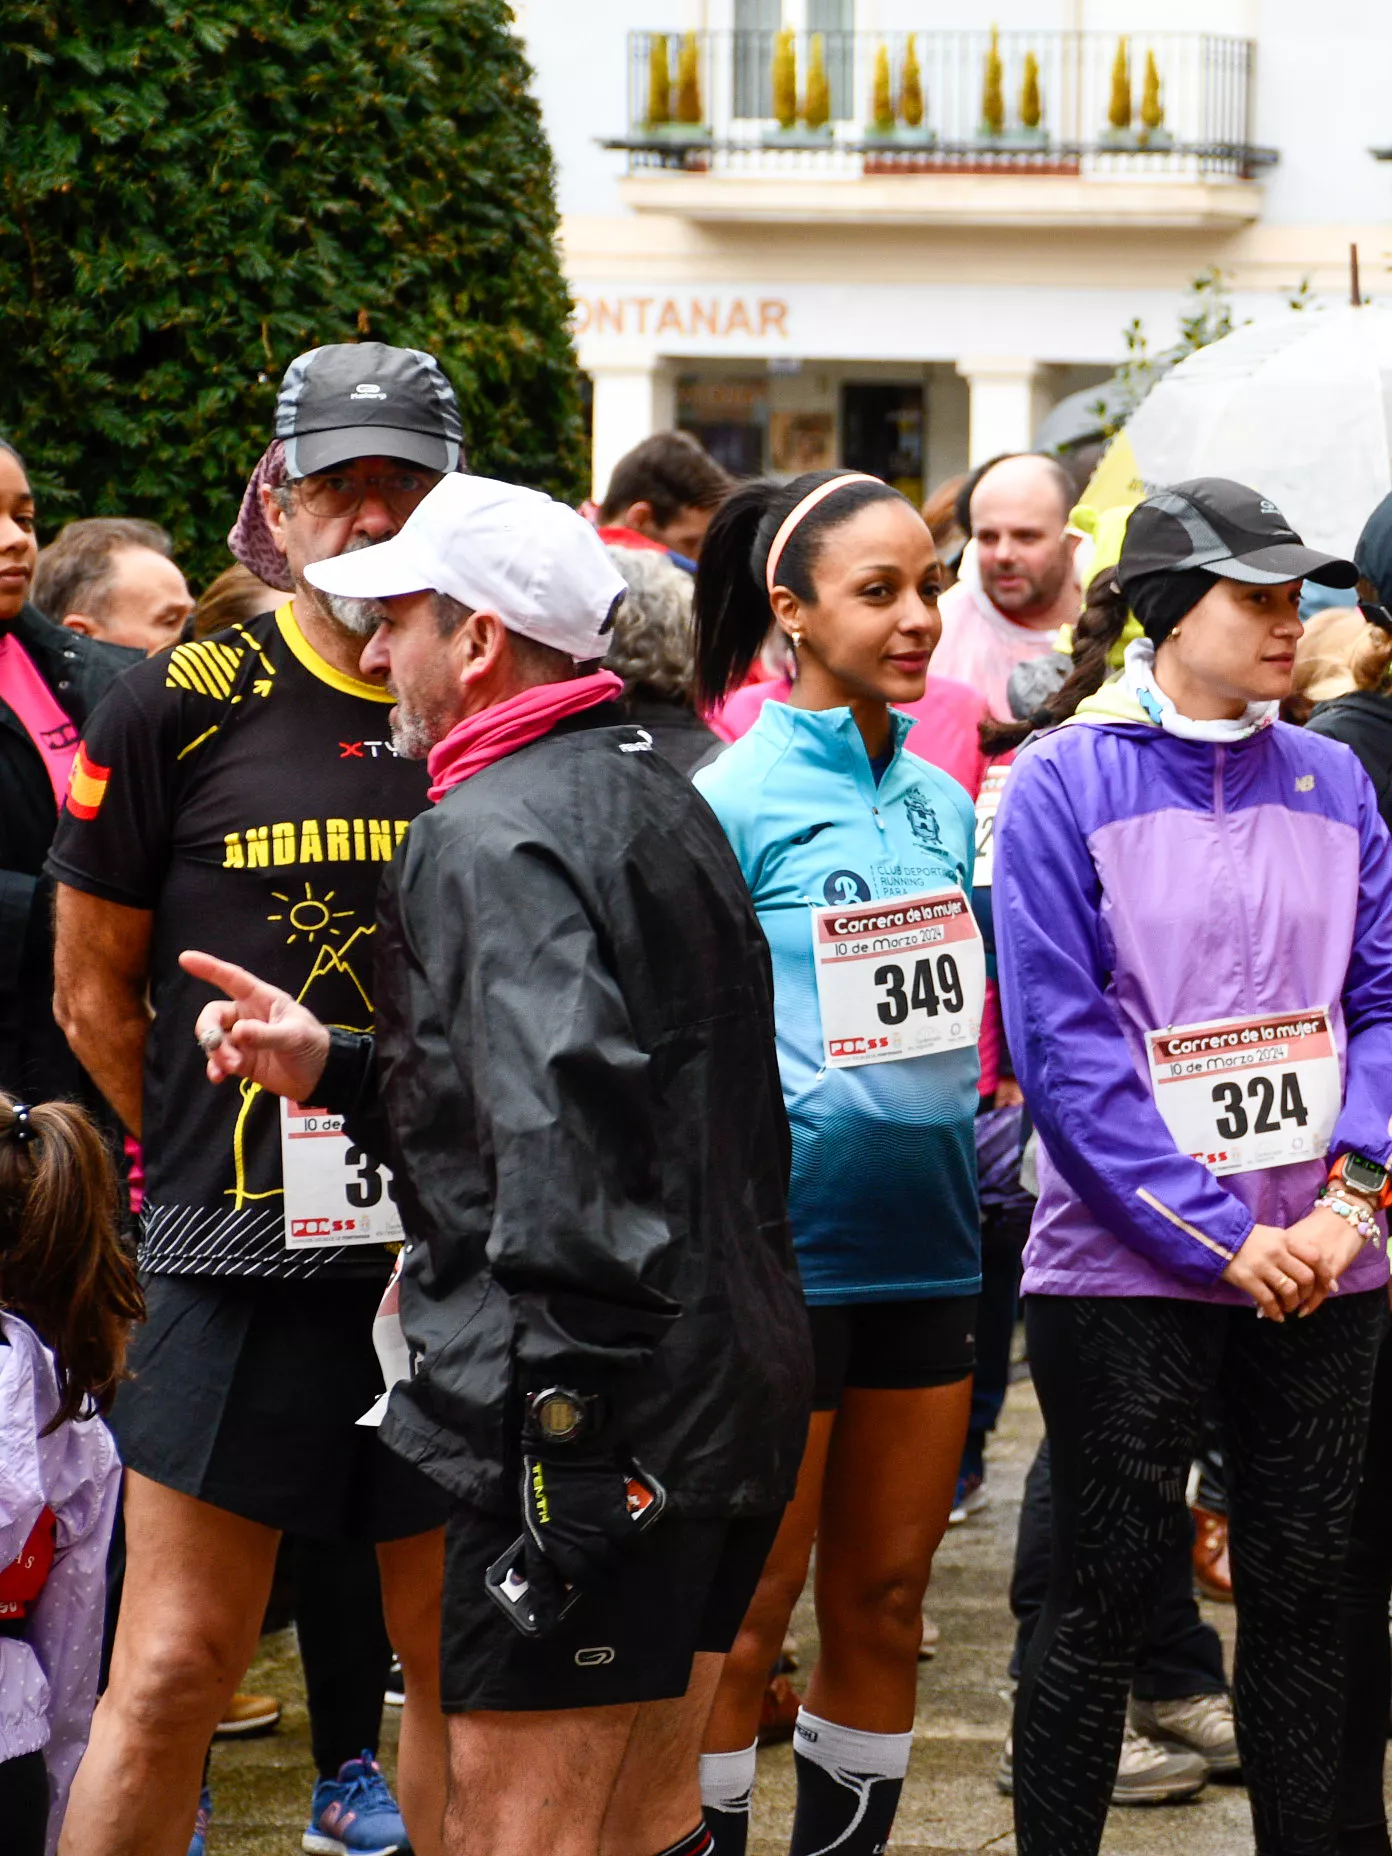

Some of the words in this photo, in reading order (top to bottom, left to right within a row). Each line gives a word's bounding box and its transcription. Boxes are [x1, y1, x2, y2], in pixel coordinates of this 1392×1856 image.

[877, 865, 901, 876] CLUB
[880, 877, 925, 888] RUNNING
[883, 887, 909, 896] PARA
[834, 913, 904, 934] Carrera
[906, 908, 921, 923] de
[922, 905, 934, 921] la
[934, 901, 962, 919] mujer
[835, 943, 848, 956] 10
[851, 941, 869, 954] de
[873, 936, 918, 951] Marzo
[920, 926, 942, 943] 2024
[874, 953, 964, 1026] 349
[1168, 1033, 1239, 1056] Carrera
[1241, 1028, 1260, 1043] de
[1261, 1025, 1275, 1041] la
[1276, 1019, 1320, 1041] mujer
[1170, 1063, 1183, 1077] 10
[1186, 1060, 1203, 1074] de
[1207, 1053, 1254, 1071] Marzo
[1256, 1047, 1285, 1062] 2024
[1211, 1072, 1309, 1140] 324
[304, 1118, 318, 1132] 10
[322, 1118, 341, 1131] de
[345, 1146, 396, 1208] 3
